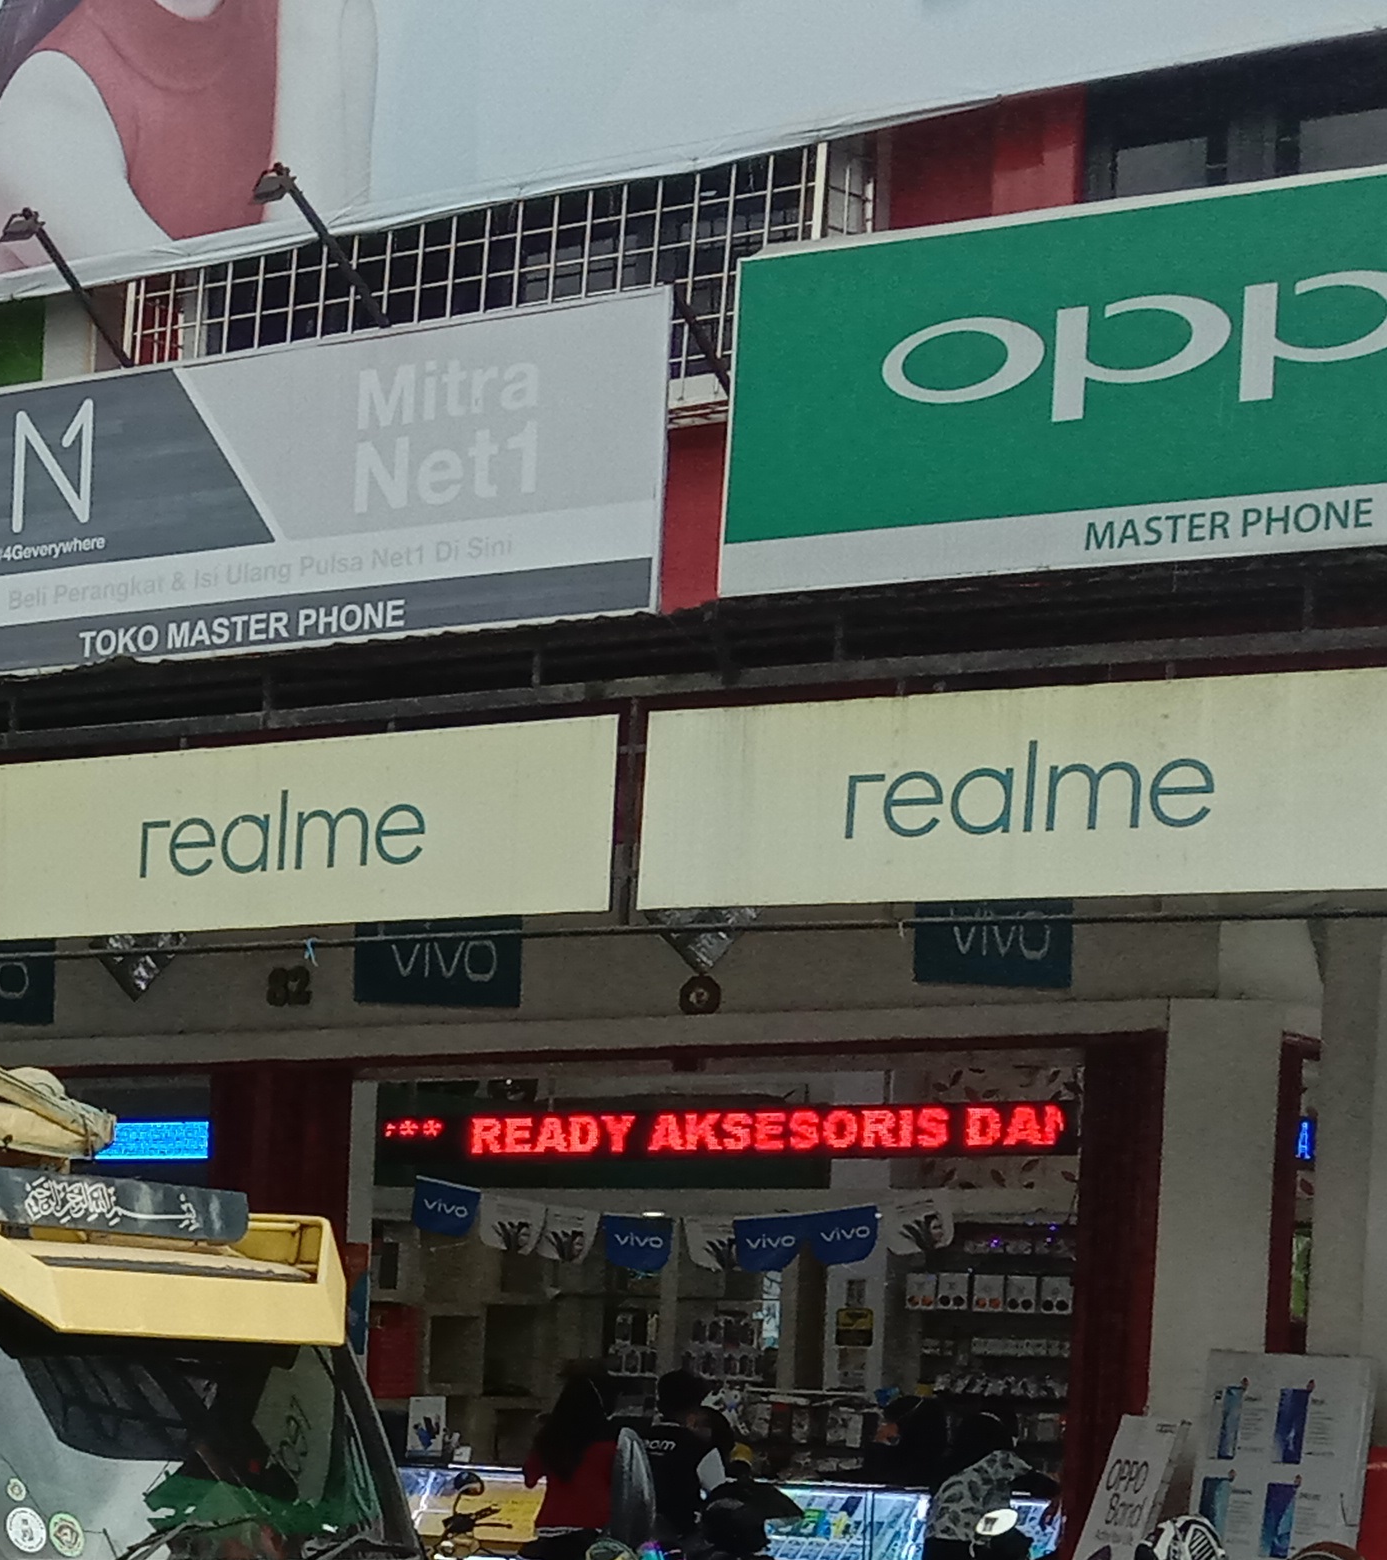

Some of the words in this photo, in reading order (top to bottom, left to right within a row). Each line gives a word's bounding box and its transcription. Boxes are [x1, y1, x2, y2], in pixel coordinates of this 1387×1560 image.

[357, 358, 539, 430] Mitra
[353, 420, 537, 514] Net1
[1085, 511, 1230, 551] MASTER
[1242, 498, 1373, 538] PHONE
[8, 588, 48, 612] Beli
[53, 574, 167, 605] Perangkat
[171, 571, 188, 592] &
[193, 565, 221, 590] Isi
[226, 559, 292, 589] Ulang
[300, 553, 363, 577] Pulsa
[370, 542, 425, 571] Net1
[435, 538, 461, 563] Di
[467, 535, 513, 560] Sini
[79, 624, 158, 659] TOKO
[166, 611, 290, 650] MASTER
[297, 599, 407, 638] PHONE
[845, 739, 1216, 840] realme
[139, 789, 426, 878] realme
[470, 1114, 636, 1155] READY
[647, 1108, 950, 1153] AKSESORIS
[423, 1198, 469, 1219] vivo
[820, 1225, 872, 1243] vivo
[614, 1232, 664, 1249] vivo
[745, 1232, 796, 1250] vivo
